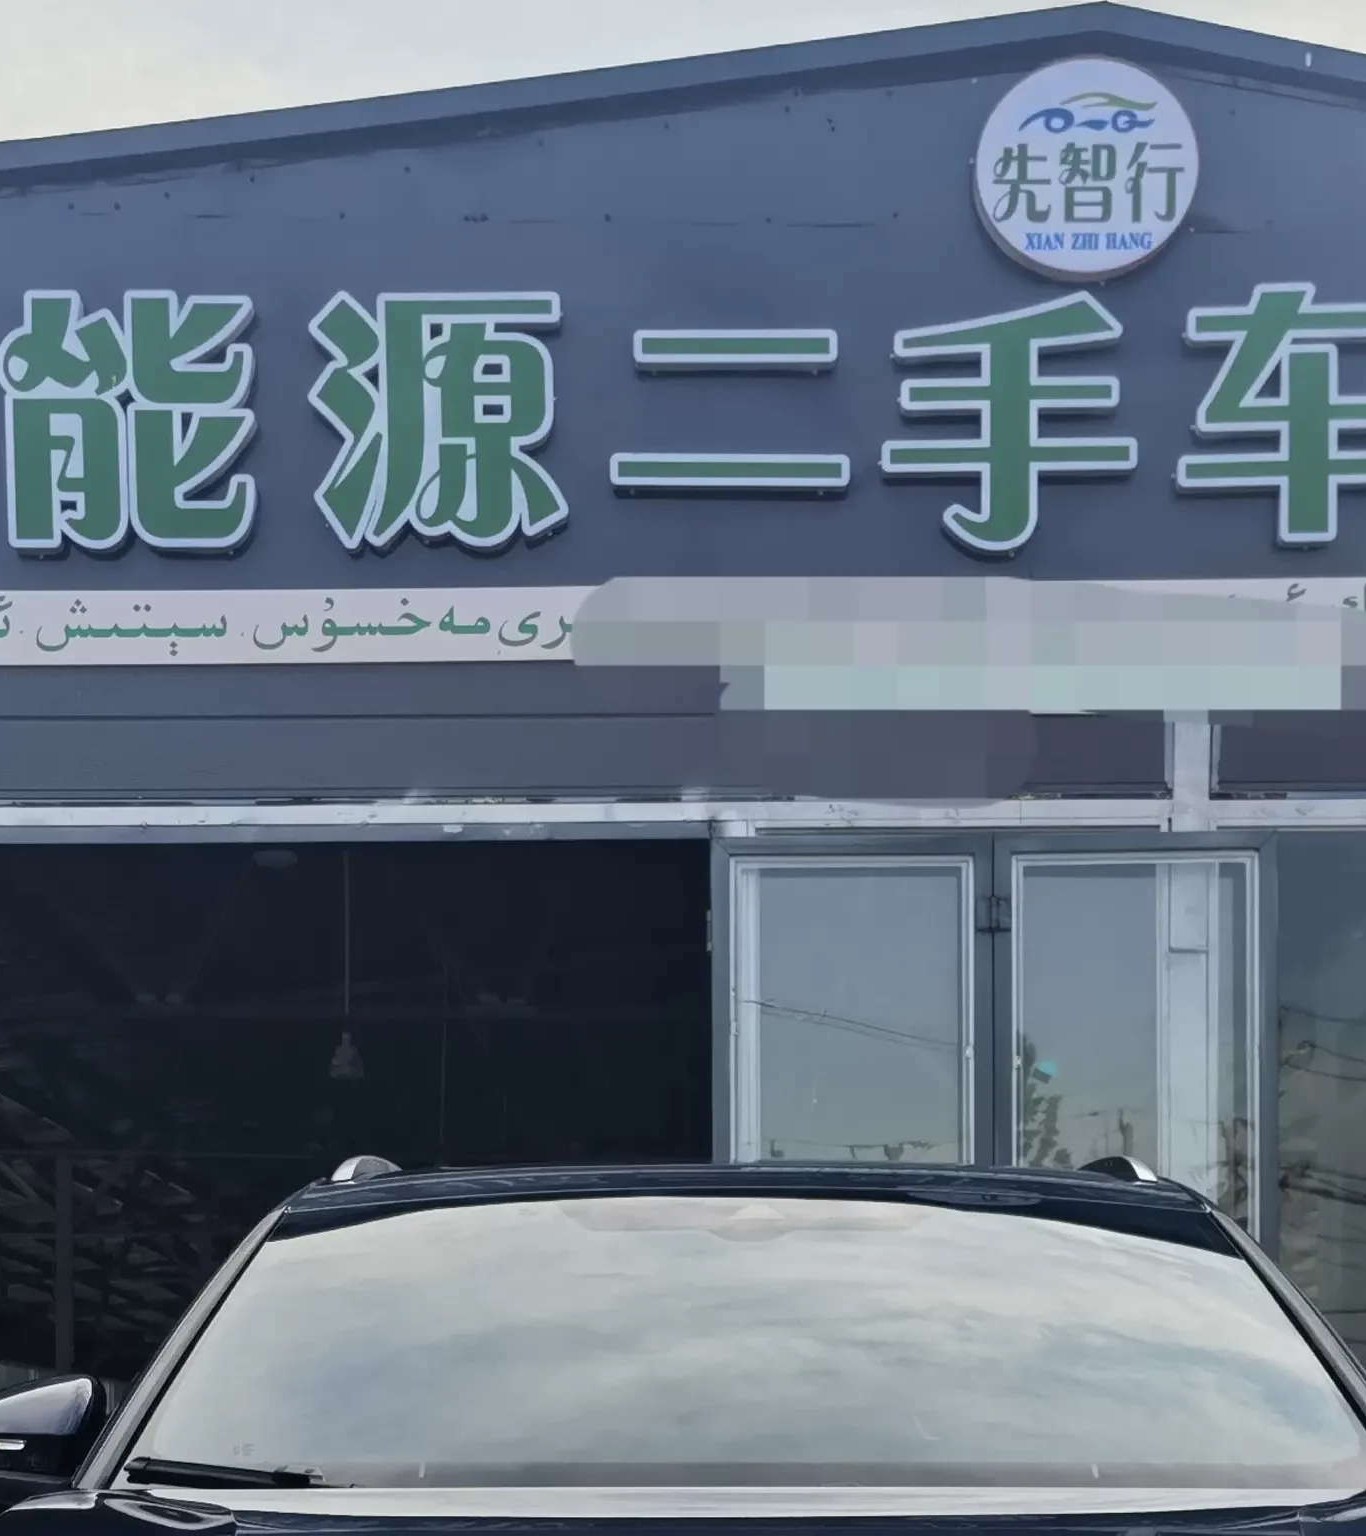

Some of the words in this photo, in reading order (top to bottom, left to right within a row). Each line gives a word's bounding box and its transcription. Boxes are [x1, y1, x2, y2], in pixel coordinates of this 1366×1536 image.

[992, 142, 1185, 224] 先智行
[1025, 232, 1065, 250] XIAN
[1070, 232, 1100, 250] ZHI
